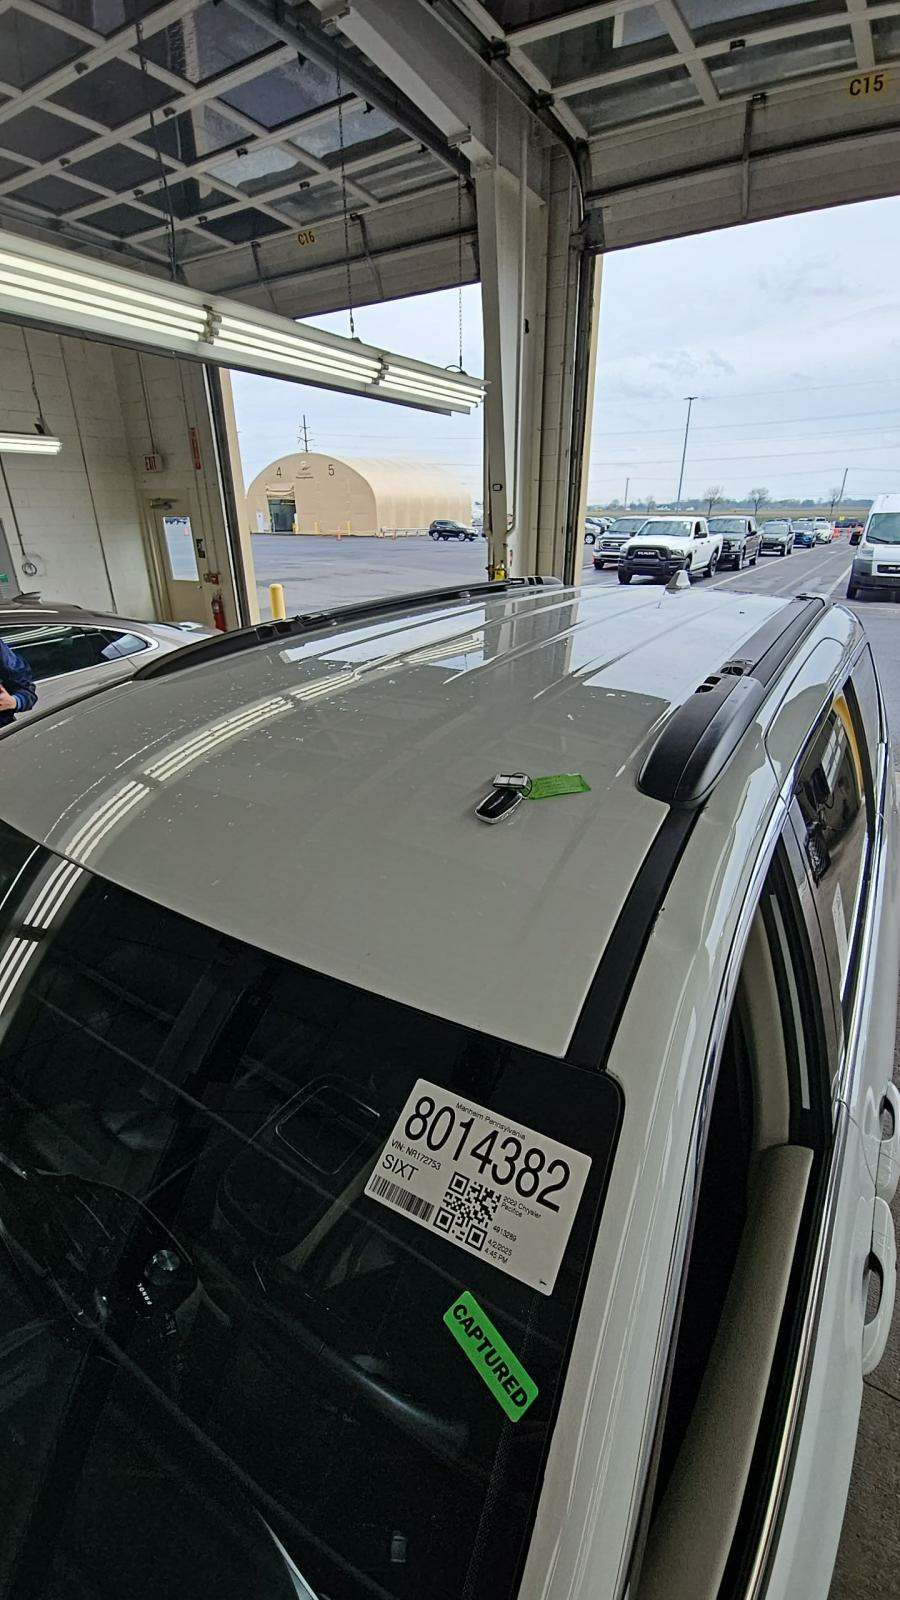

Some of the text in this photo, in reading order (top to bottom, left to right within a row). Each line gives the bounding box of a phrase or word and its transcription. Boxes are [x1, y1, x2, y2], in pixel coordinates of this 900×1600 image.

[850, 74, 884, 96] C15
[297, 230, 315, 246] C16
[275, 466, 283, 478] 4
[327, 464, 336, 477] 5
[484, 1115, 526, 1140] Pennsylvania
[382, 1154, 420, 1180] SIXT
[391, 1139, 442, 1171] VIN: NR172753
[404, 1096, 571, 1213] 8014382
[453, 1304, 528, 1407] CAPTURED
